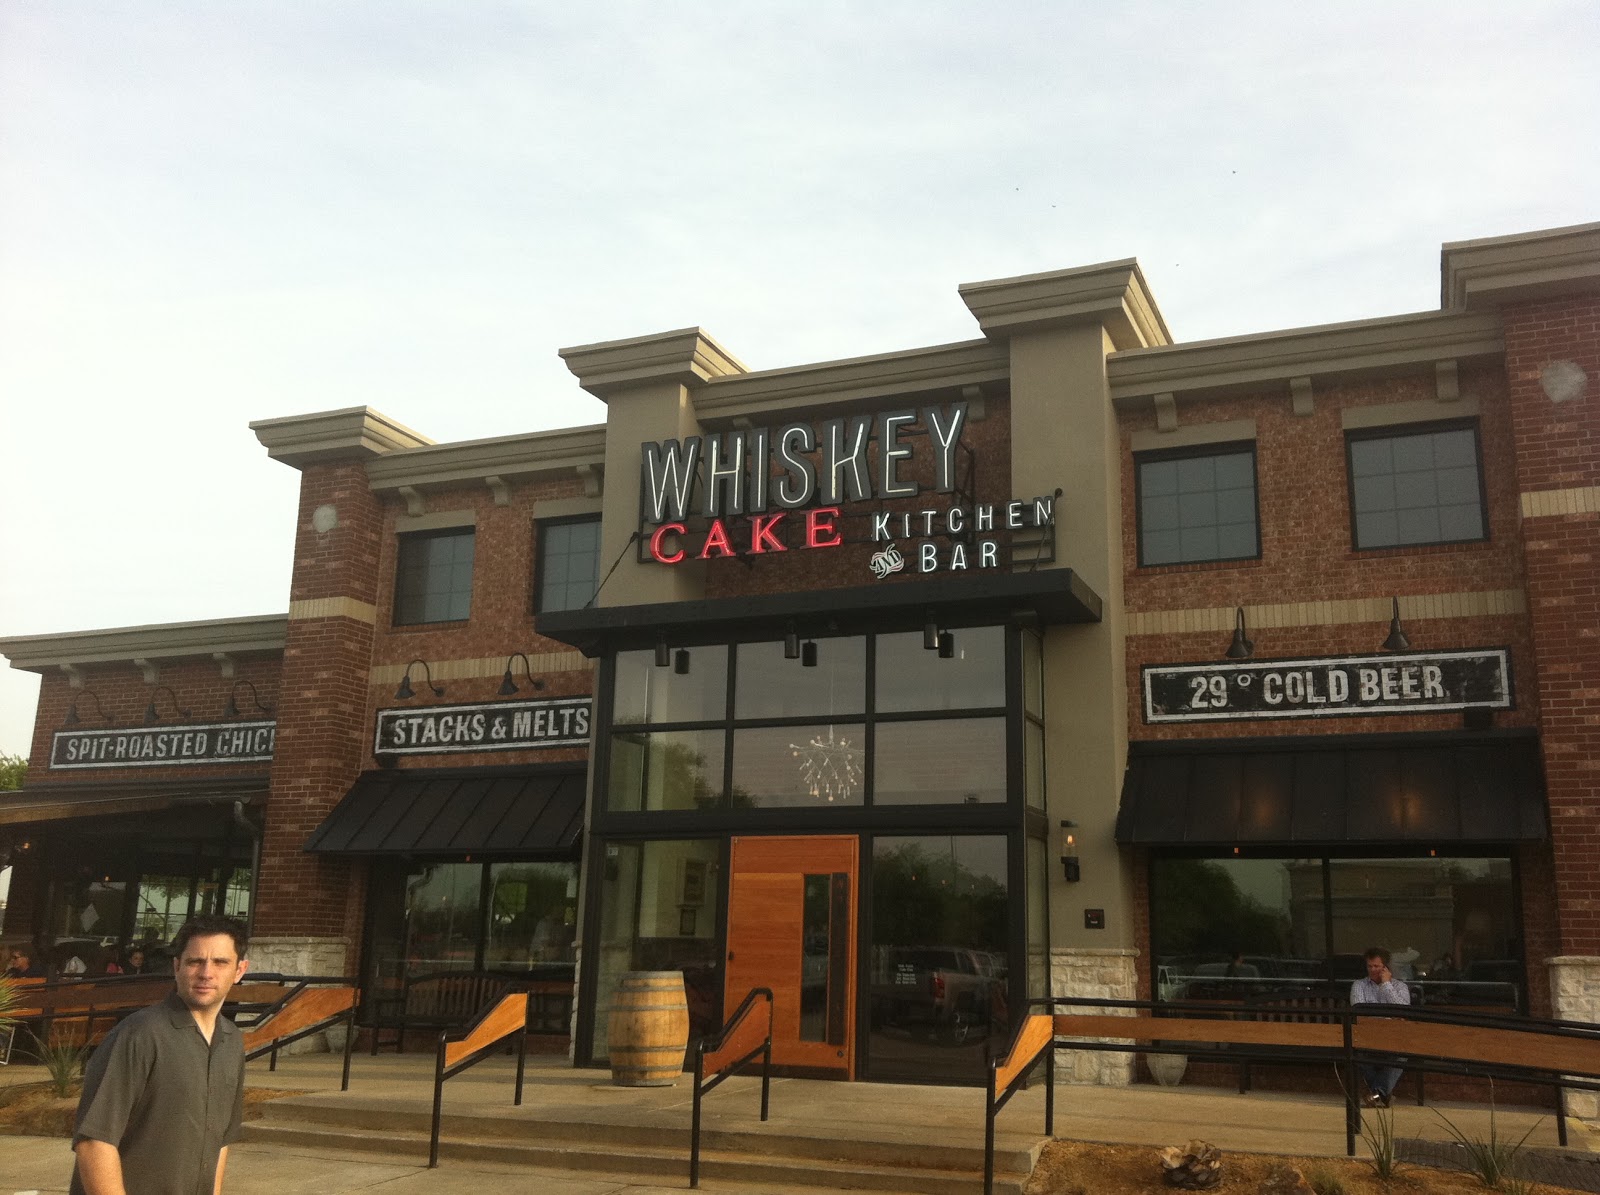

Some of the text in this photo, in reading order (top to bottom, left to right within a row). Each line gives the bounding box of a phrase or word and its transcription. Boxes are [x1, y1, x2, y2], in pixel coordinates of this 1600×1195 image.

[641, 402, 968, 524] WHISKEY
[648, 506, 843, 564] CAKE
[870, 497, 1056, 542] KITCHEN
[918, 540, 999, 574] BAR
[1262, 669, 1349, 705] COLD
[1358, 664, 1446, 701] BEER
[66, 732, 208, 761] SPIT-ROASTED
[393, 707, 590, 745] STACKS & MELTS
